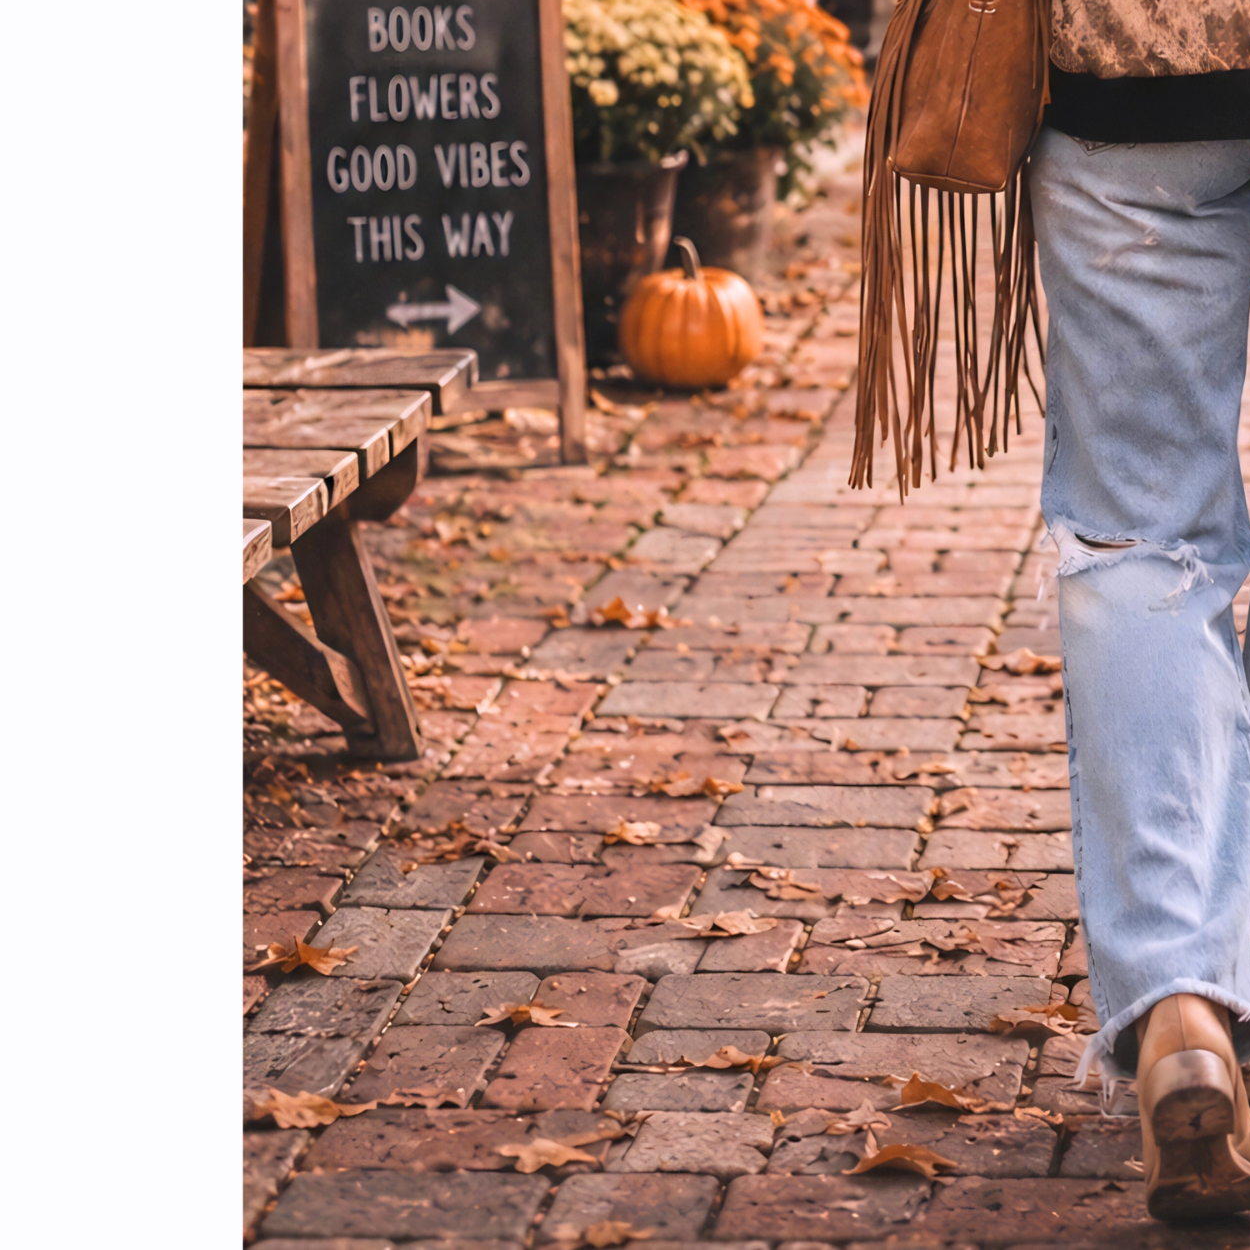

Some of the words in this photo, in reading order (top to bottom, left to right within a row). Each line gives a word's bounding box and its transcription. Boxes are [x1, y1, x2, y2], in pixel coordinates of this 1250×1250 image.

[367, 4, 476, 53] BOOKS
[349, 72, 501, 122] FLOWERS
[326, 144, 418, 194] GOOD
[433, 140, 531, 189] VIBES
[346, 213, 425, 263] THIS
[441, 210, 514, 258] WAY
